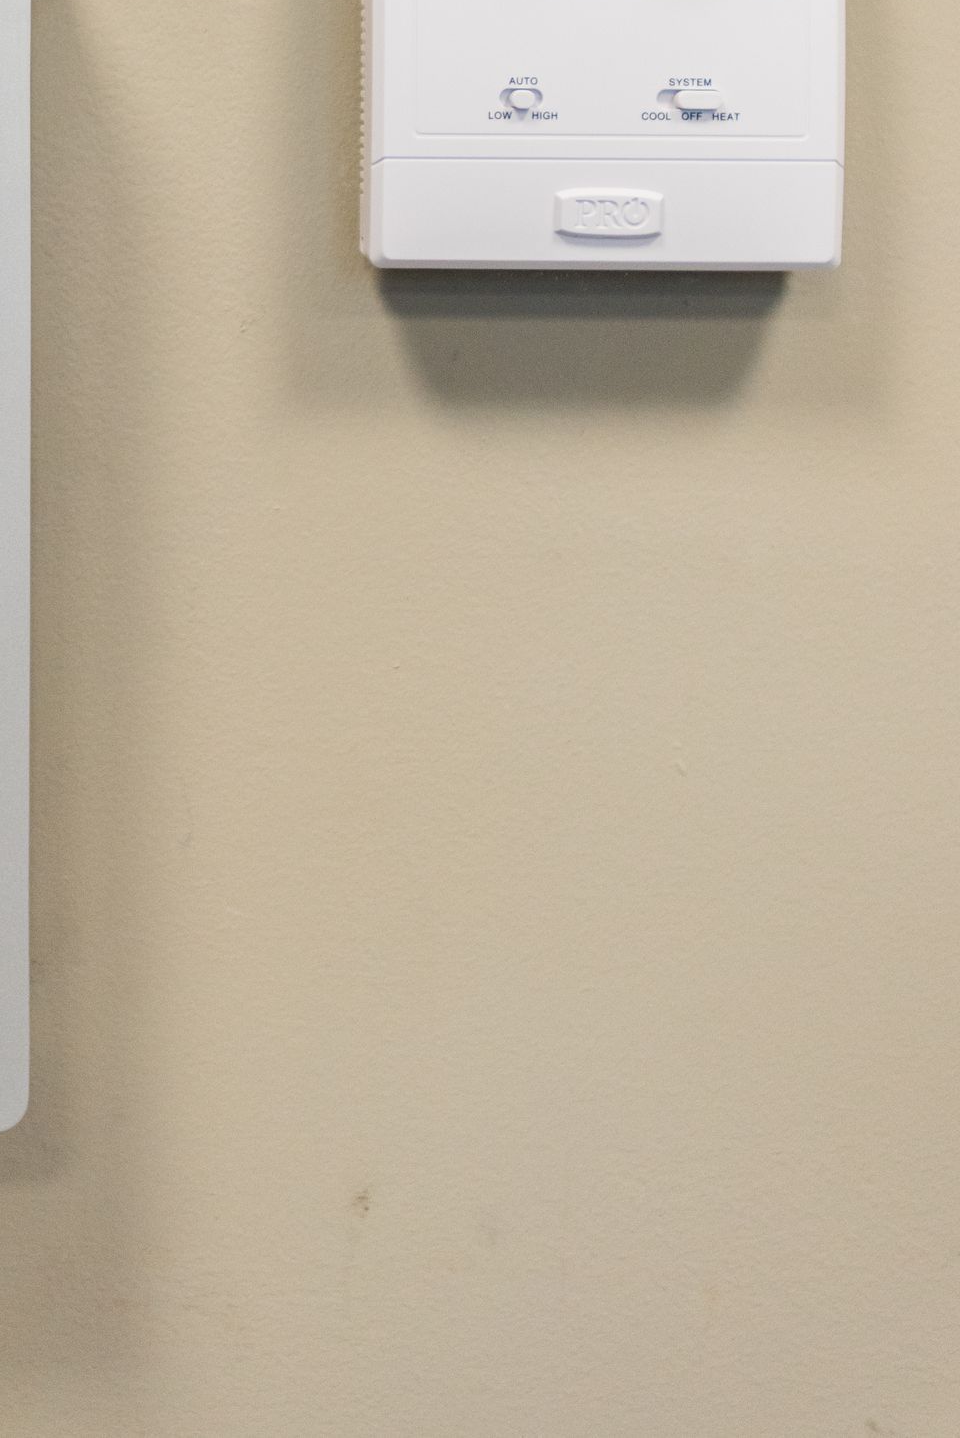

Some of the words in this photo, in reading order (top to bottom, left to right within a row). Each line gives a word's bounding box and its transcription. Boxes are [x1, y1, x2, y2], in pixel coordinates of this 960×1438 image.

[509, 77, 538, 86] AUTO
[669, 78, 712, 87] SYSTEM
[488, 112, 513, 120] LOW
[531, 112, 558, 120] HIGH
[641, 112, 671, 121] COOL
[681, 112, 703, 121] OFF
[712, 112, 740, 121] HEAT
[574, 197, 651, 229] PRO
